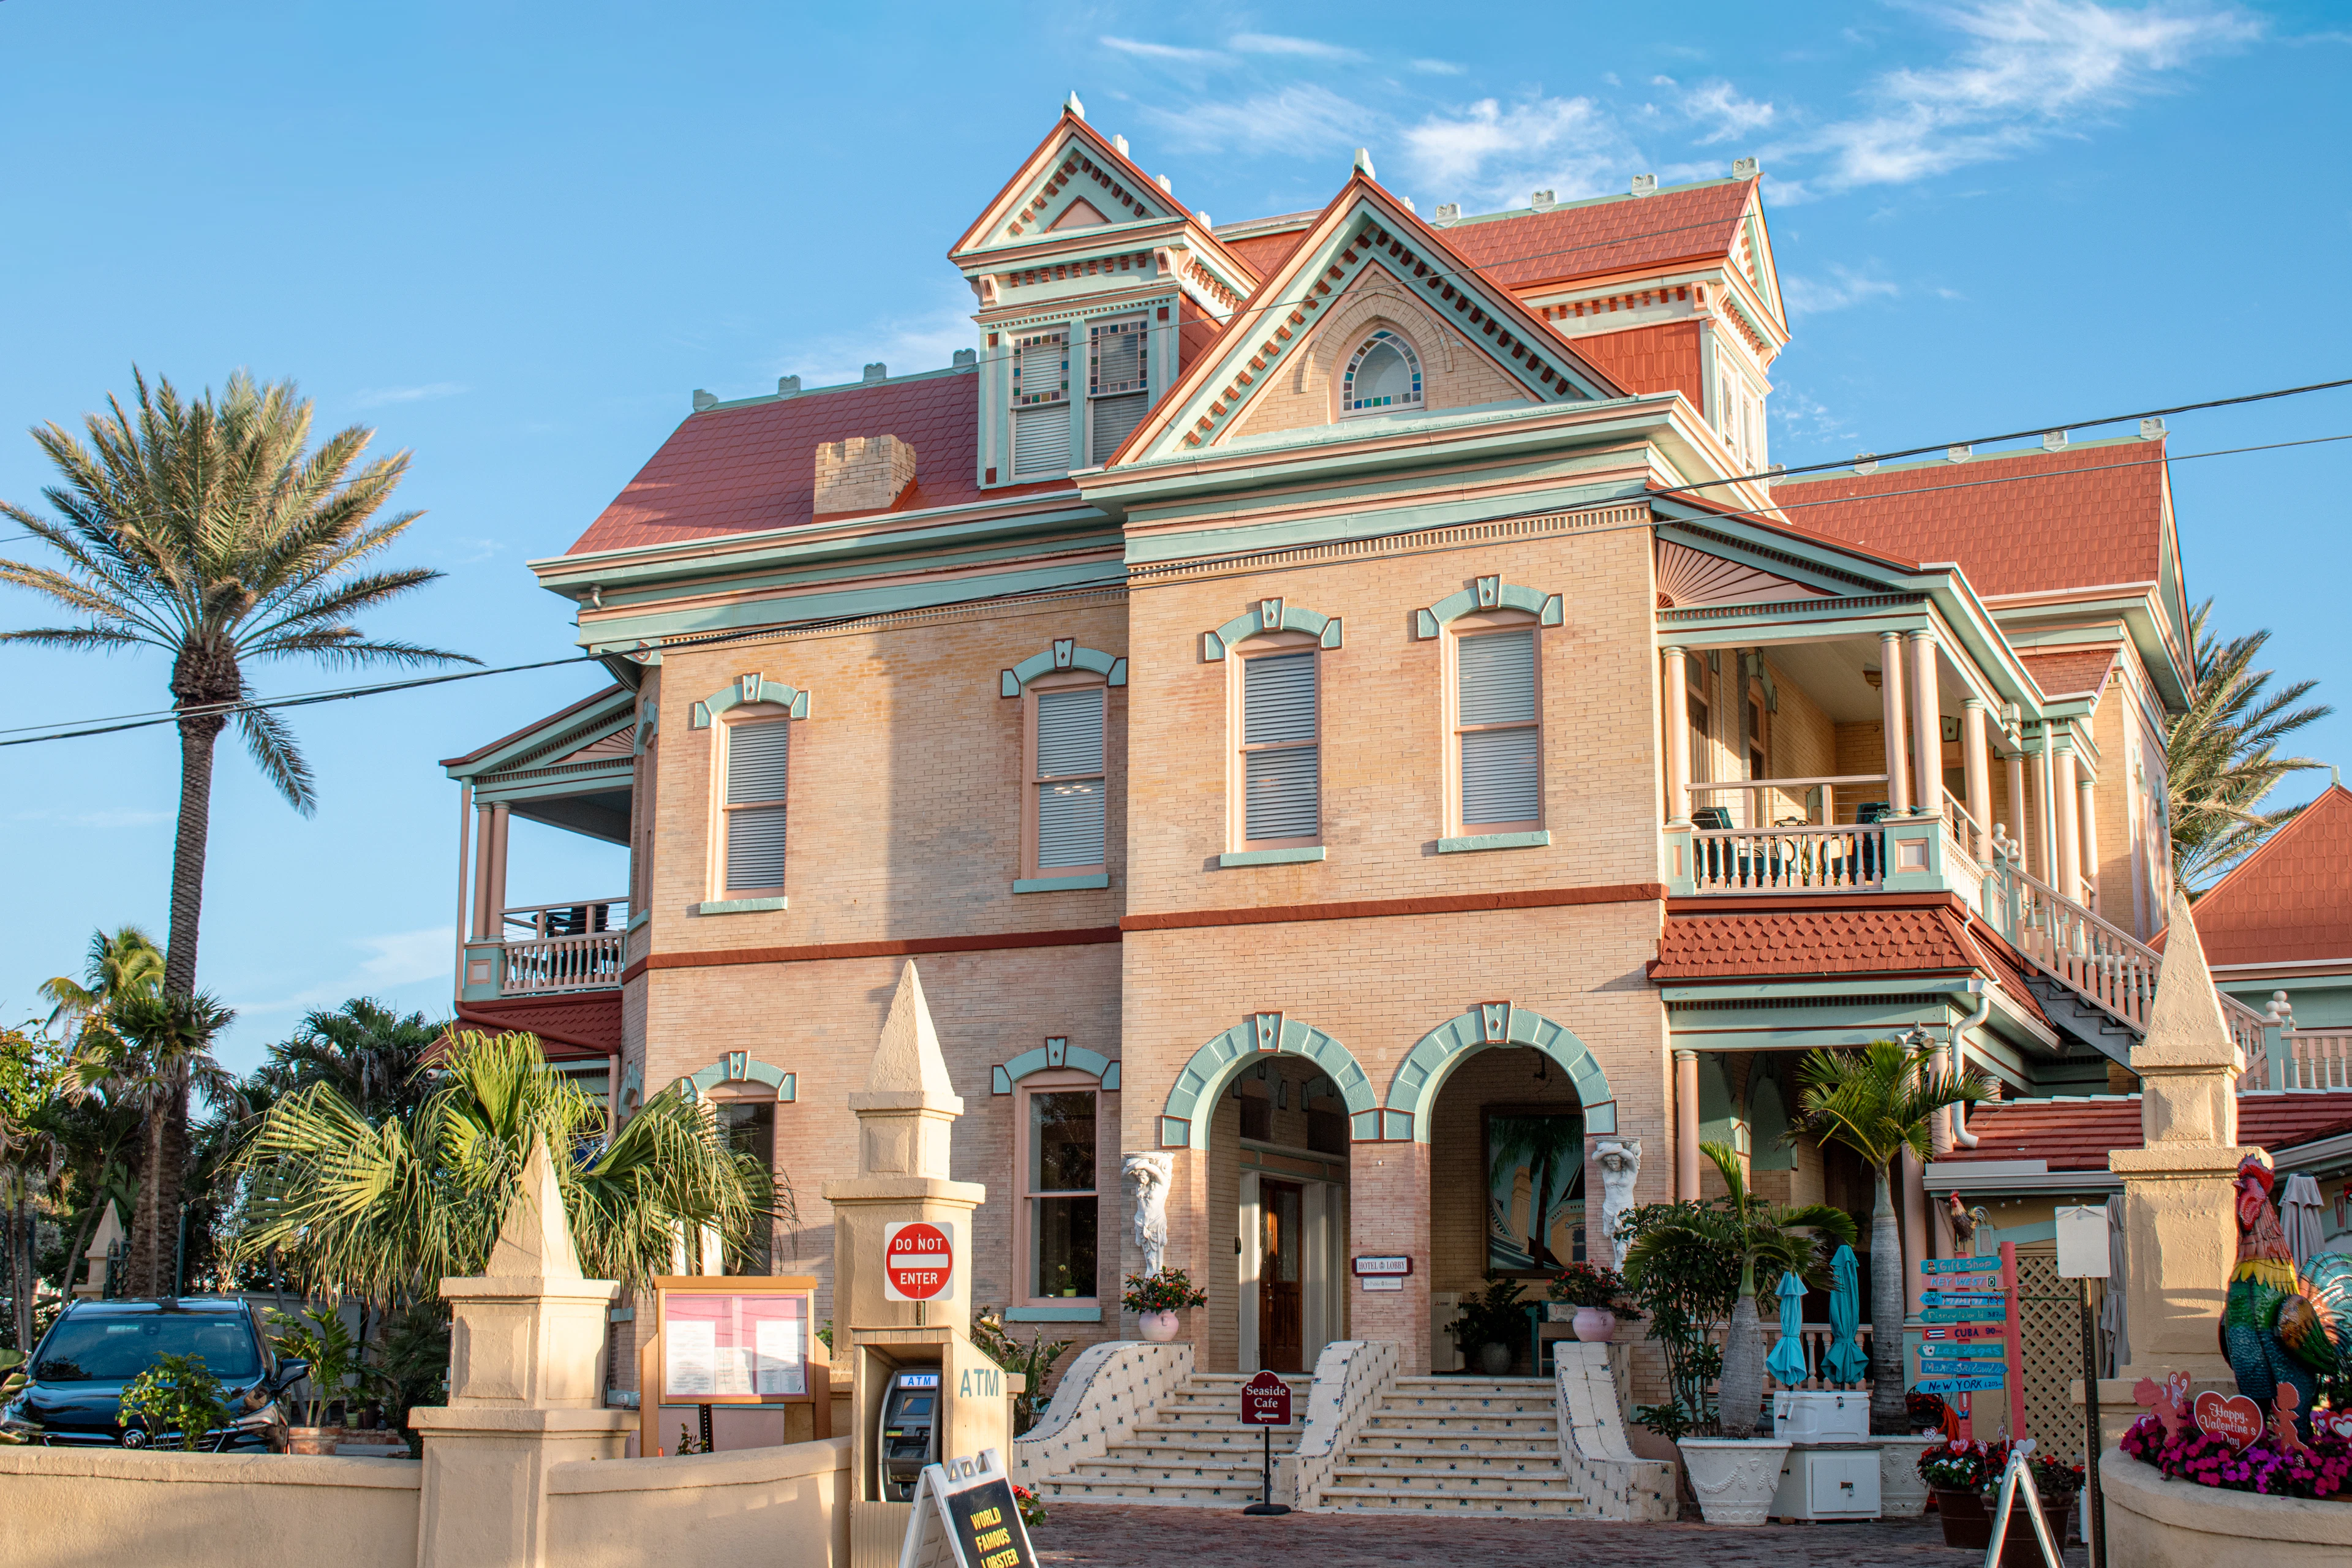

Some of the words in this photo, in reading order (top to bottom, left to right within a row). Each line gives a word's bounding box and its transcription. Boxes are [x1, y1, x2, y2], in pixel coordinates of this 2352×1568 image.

[895, 1238, 912, 1251] DO
[918, 1238, 943, 1251] NOT
[1386, 1261, 1405, 1270] LOBBY
[1966, 1259, 1992, 1269] Shop
[900, 1272, 938, 1284] ENTER
[1930, 1276, 1952, 1286] KEY
[1955, 1276, 1986, 1286] WEST
[1954, 1328, 1979, 1338] CUBA
[1936, 1346, 1958, 1355] Las
[1963, 1345, 2001, 1357] Vegas
[908, 1376, 931, 1385] ATM
[959, 1368, 999, 1398] ATM
[1956, 1379, 1982, 1390] YORK
[1246, 1385, 1286, 1396] Seaside
[1254, 1397, 1278, 1408] Cafe
[2218, 1431, 2240, 1449] Day
[970, 1506, 1002, 1531] WORLD
[974, 1527, 1011, 1553] FAMOUS
